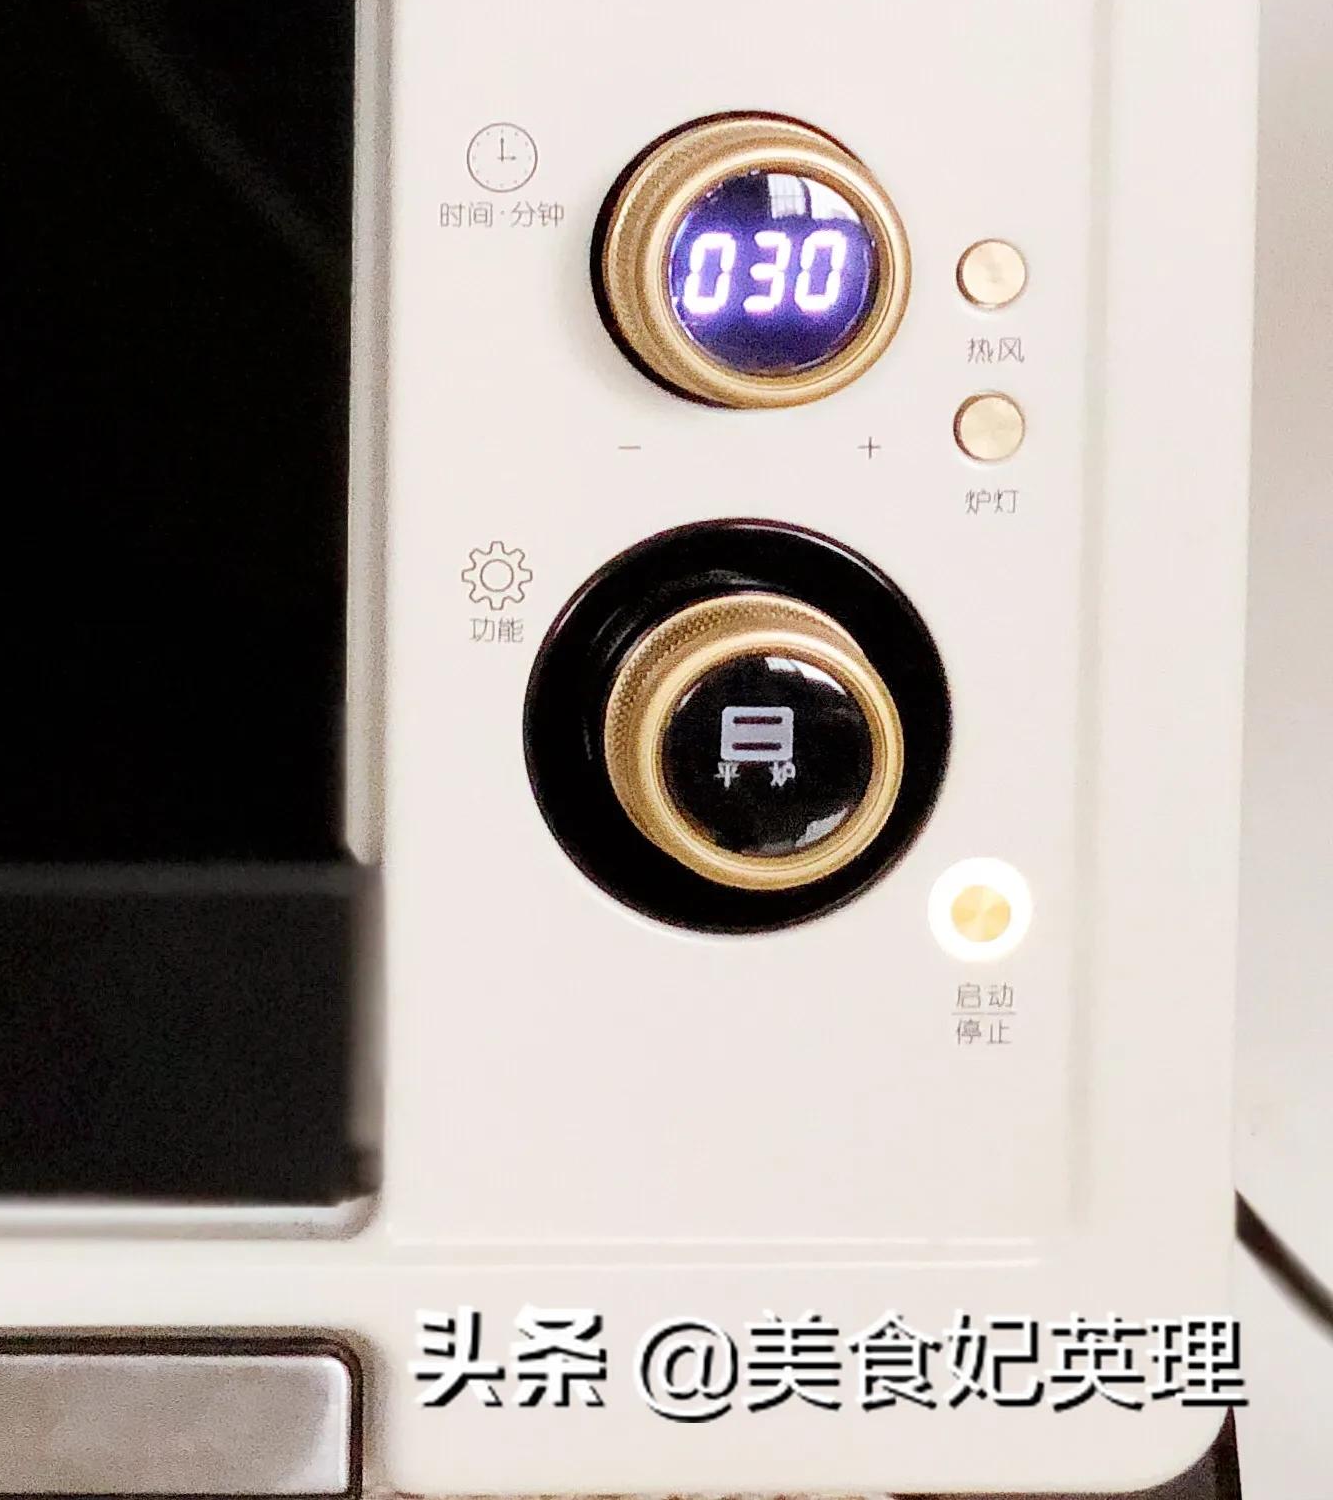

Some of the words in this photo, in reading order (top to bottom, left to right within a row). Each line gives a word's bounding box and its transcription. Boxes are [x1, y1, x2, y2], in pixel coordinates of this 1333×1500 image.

[682, 229, 849, 315] 030
[967, 336, 1026, 364] 热风
[964, 488, 1020, 516] 炉灯
[469, 615, 525, 644] 功能
[956, 981, 1014, 1008] 启动
[956, 1018, 1012, 1045] 停止
